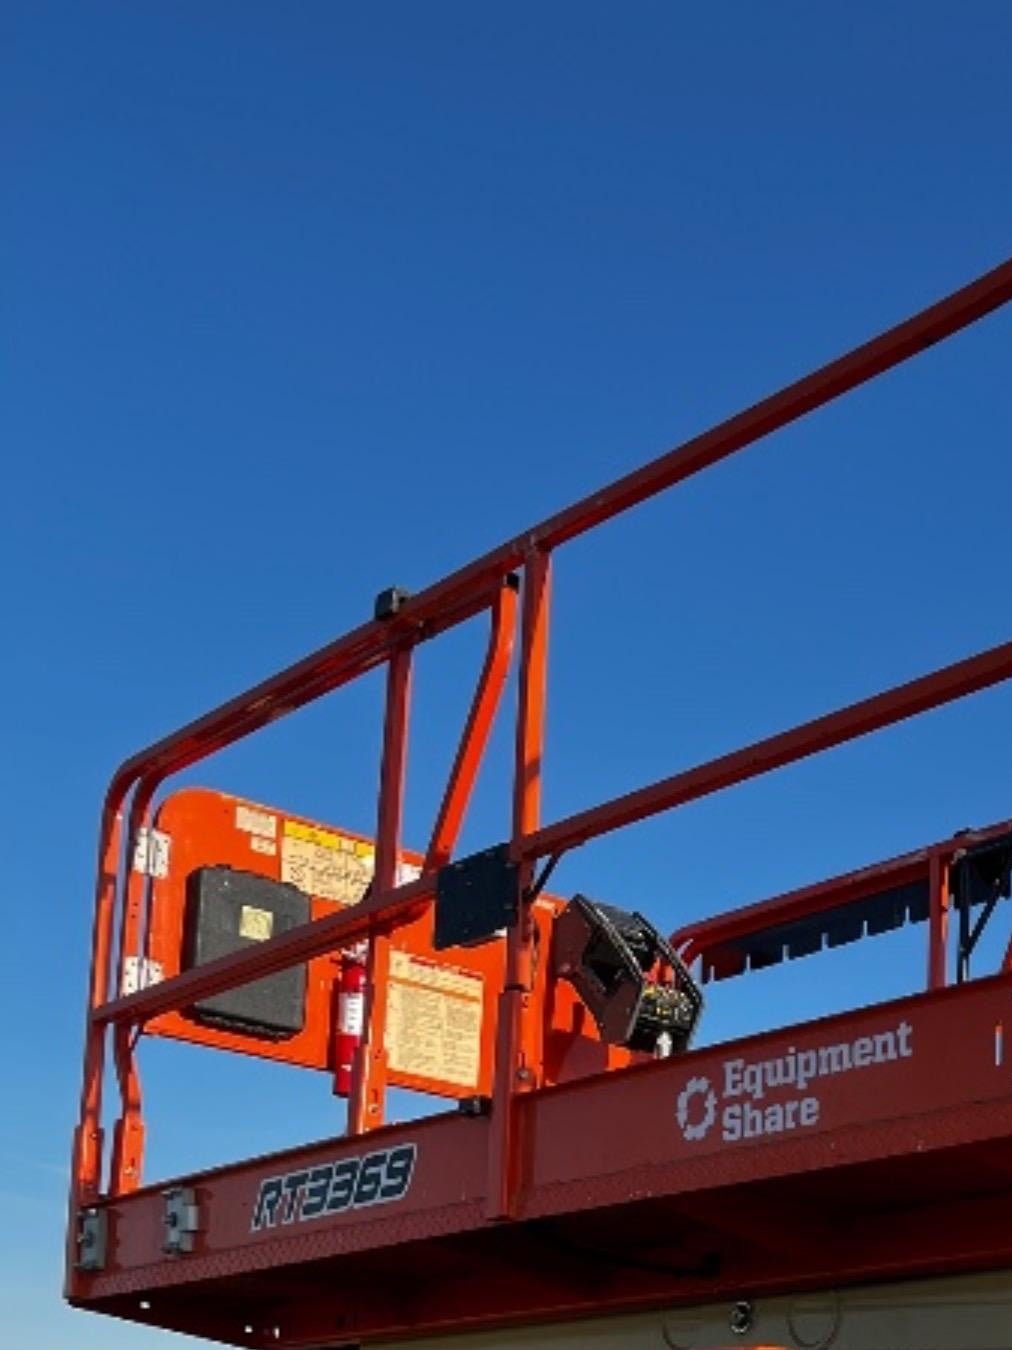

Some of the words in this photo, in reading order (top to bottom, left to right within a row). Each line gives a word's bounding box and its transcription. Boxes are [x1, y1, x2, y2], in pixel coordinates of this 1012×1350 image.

[722, 1020, 913, 1099] Equipment
[722, 1097, 819, 1141] Share
[251, 1143, 417, 1232] RT3369
